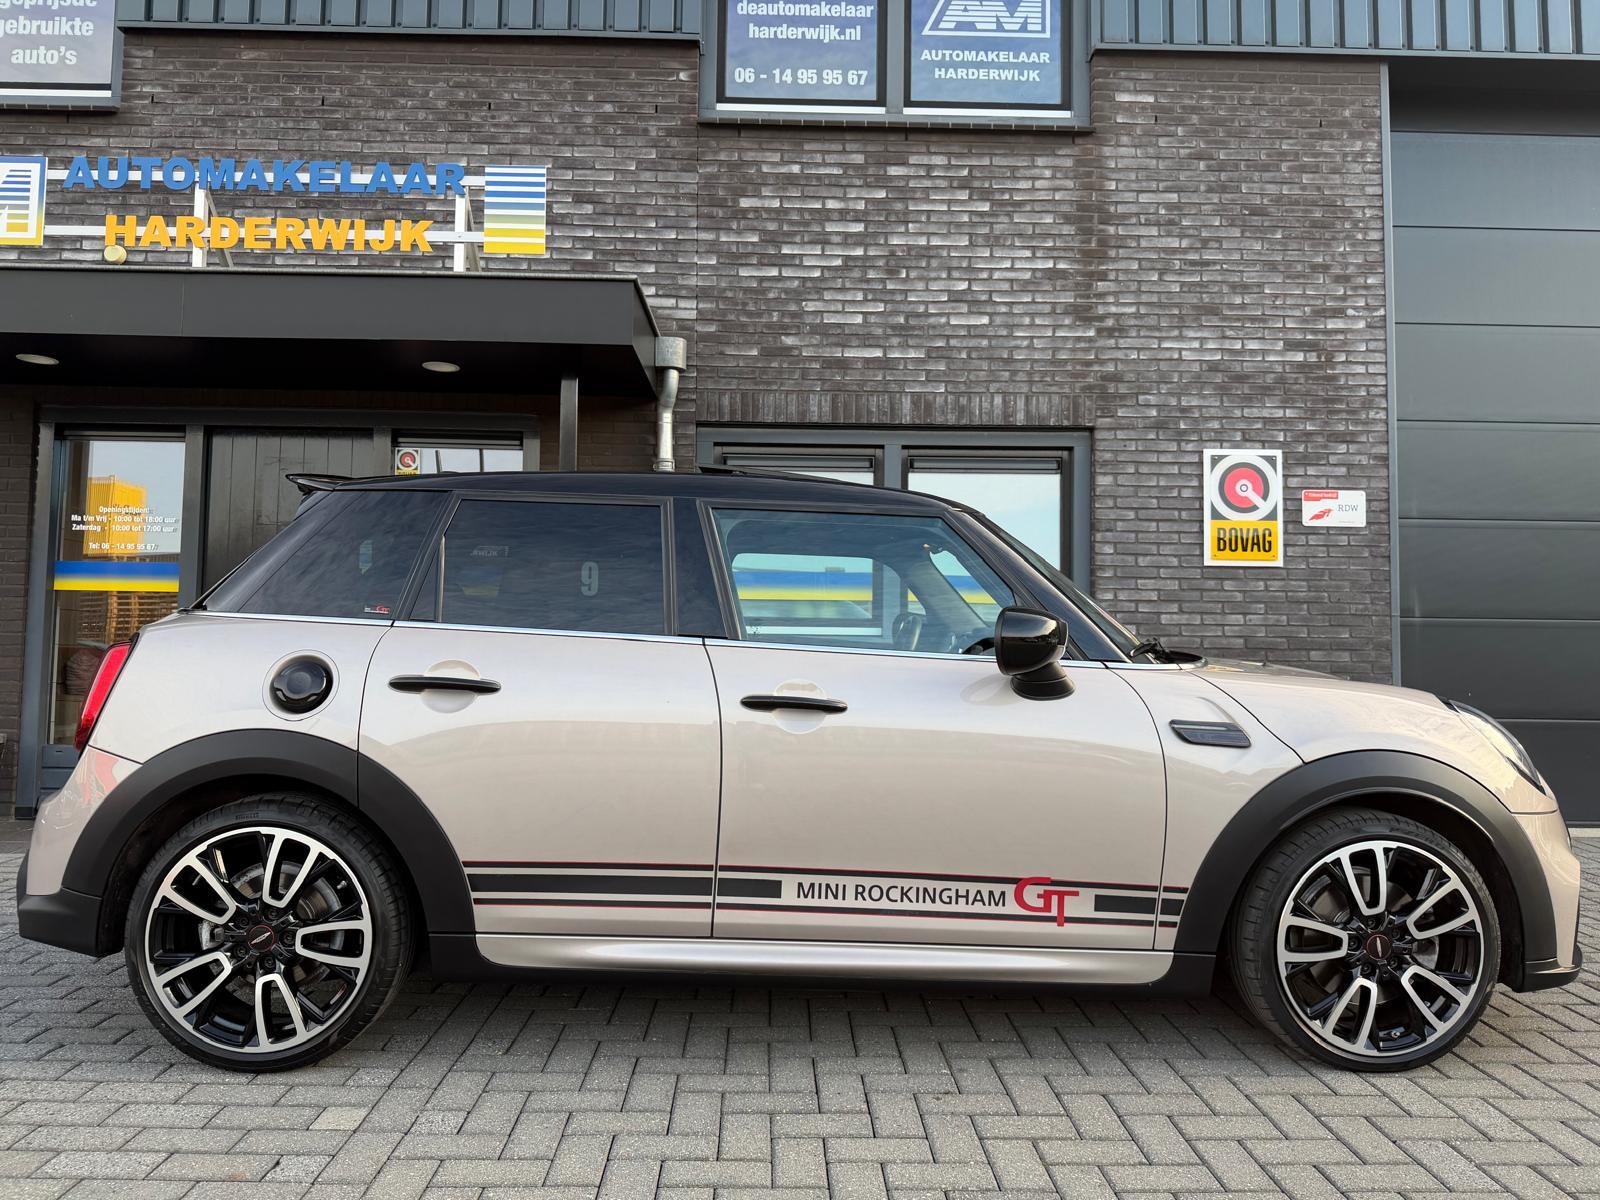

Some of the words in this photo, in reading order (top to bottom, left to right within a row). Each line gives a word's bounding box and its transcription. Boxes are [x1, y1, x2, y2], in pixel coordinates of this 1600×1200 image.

[737, 0, 874, 17] deautomakelaar
[749, 23, 861, 43] harderwijk.nl
[11, 45, 78, 65] auto's
[920, 49, 1050, 63] AUTOMAKELAAR
[734, 67, 755, 83] 06
[772, 68, 793, 84] 14
[797, 69, 817, 85] 95
[822, 69, 843, 85] 95
[847, 70, 868, 86] 67
[934, 67, 1041, 81] HARDERWIJK
[62, 155, 466, 196] AUTOMAKELAAR
[104, 214, 434, 252] HARDERWIJK
[72, 523, 101, 532] Zaterdag
[96, 515, 107, 523] Vrij
[1217, 527, 1272, 553] BOVAG
[580, 560, 599, 597] 9
[796, 881, 847, 901] MINI
[854, 883, 1007, 908] ROCKINGHAM
[1013, 877, 1080, 927] GT
